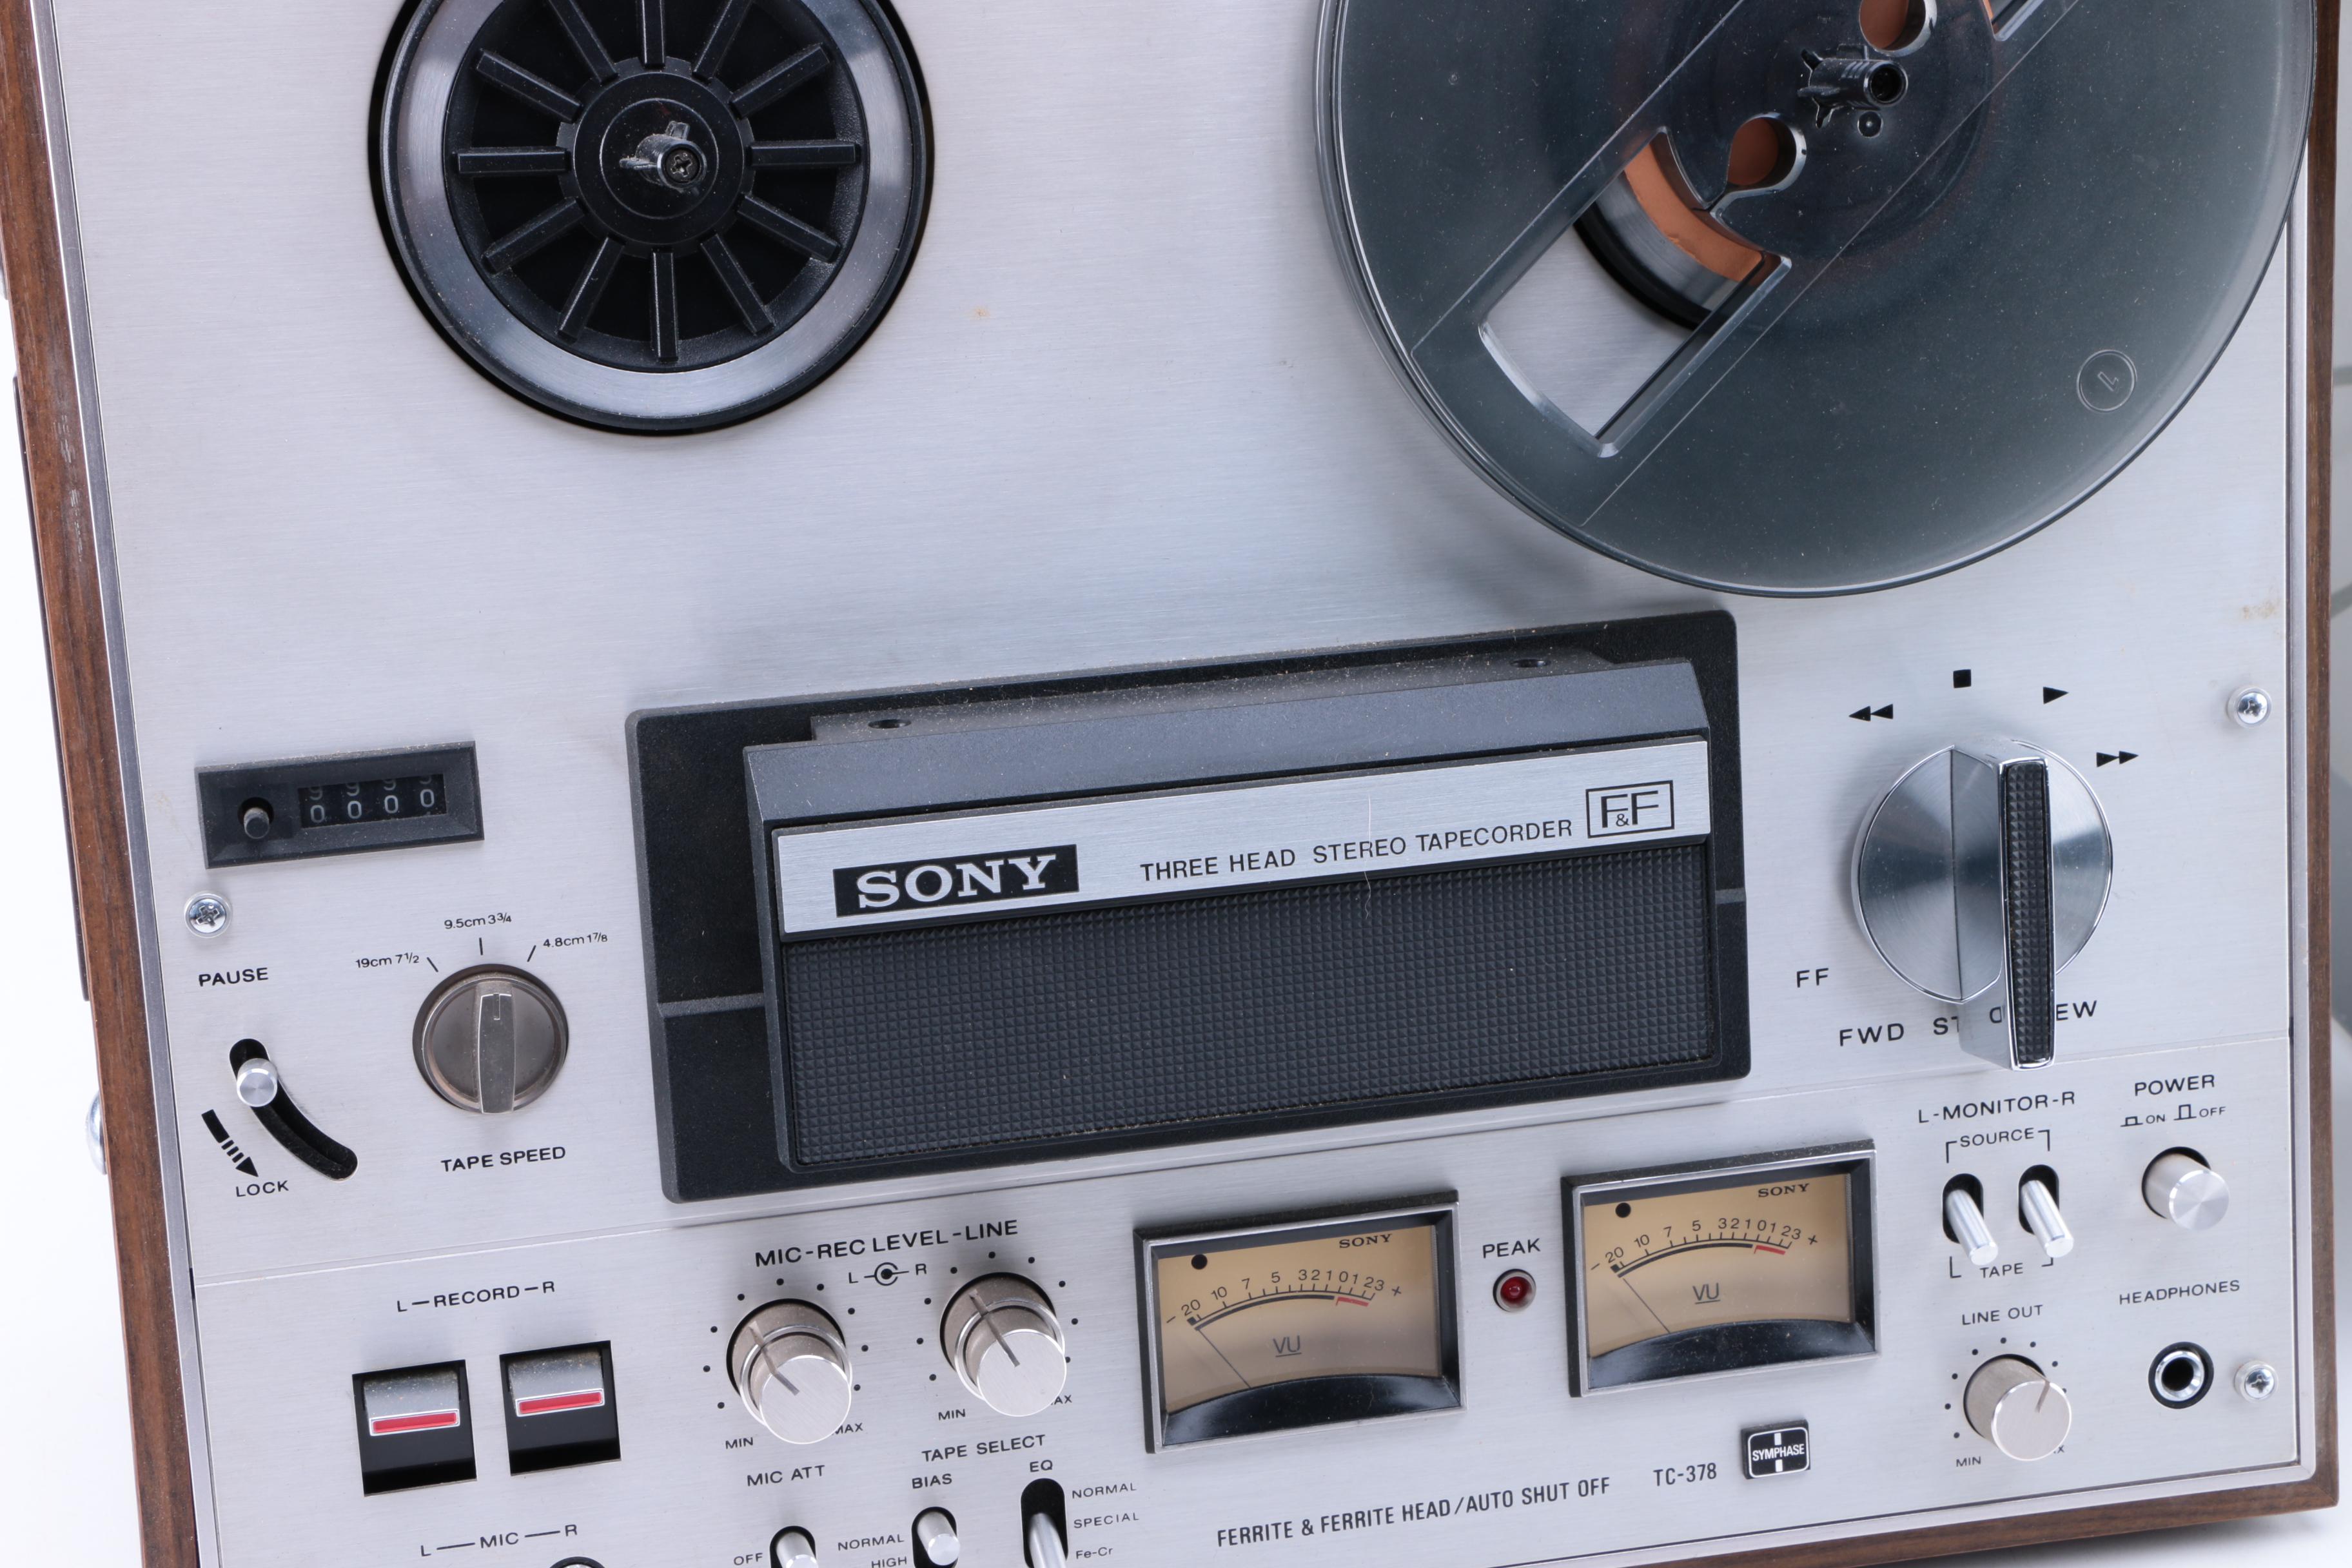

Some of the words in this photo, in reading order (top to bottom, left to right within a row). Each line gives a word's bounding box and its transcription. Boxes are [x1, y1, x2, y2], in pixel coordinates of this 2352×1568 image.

[1140, 857, 1218, 881] THREE
[1230, 849, 1295, 872] HEAD
[1313, 837, 1407, 864] STEREO
[1415, 819, 1573, 852] TAPECORDER
[856, 854, 1057, 909] SONY
[444, 918, 485, 929] 9.5cm
[544, 937, 584, 947] 4.8cm
[356, 957, 391, 968] 19cm
[199, 968, 268, 986] PAUSE
[1797, 968, 1828, 988] FF
[1840, 1023, 1904, 1046] FWD
[2055, 1000, 2097, 1021] EW
[2135, 1075, 2214, 1096] POWER
[2146, 1114, 2165, 1124] ON
[2199, 1106, 2225, 1117] OFF
[1961, 1128, 2034, 1147] SOURCE
[441, 1155, 493, 1171] TAPE
[500, 1147, 565, 1165] SPEED
[236, 1181, 288, 1197] LOCK
[1758, 1183, 1809, 1197] SONY
[756, 1240, 865, 1267] MIC-REC
[873, 1220, 1017, 1251] LEVEL-LINE
[1339, 1234, 1391, 1248] SONY
[1483, 1239, 1540, 1259] PEAK
[1605, 1247, 1624, 1264] 20
[1634, 1235, 1649, 1247] 10
[1663, 1226, 1671, 1237] 7
[1692, 1220, 1701, 1231] 5
[1718, 1218, 1727, 1229] 3
[1730, 1218, 1740, 1229] 2
[1745, 1219, 1750, 1229] 1
[1758, 1220, 1767, 1231] 0
[1771, 1222, 1776, 1233] 1
[1781, 1226, 1791, 1237] 2
[1792, 1228, 1801, 1239] 3
[848, 1273, 858, 1284] L
[916, 1264, 926, 1275] R
[1980, 1263, 2023, 1278] TAPE
[1181, 1300, 1200, 1316] 20
[1211, 1287, 1227, 1300] 10
[1242, 1278, 1250, 1289] 7
[1271, 1271, 1280, 1283] 5
[1298, 1269, 1307, 1280] 3
[1311, 1269, 1320, 1280] 2
[1327, 1270, 1331, 1280] 1
[1339, 1271, 1348, 1282] 0
[1353, 1274, 1358, 1284] 1
[1364, 1277, 1374, 1288] 2
[1375, 1280, 1384, 1291] 3
[1692, 1283, 1720, 1301] VU
[2120, 1280, 2239, 1304] HEADPHONES
[1963, 1310, 1999, 1325] LINE
[2008, 1305, 2043, 1319] OUT
[1273, 1336, 1301, 1354] VU
[1051, 1394, 1073, 1406] AX
[939, 1409, 965, 1420] MIN
[726, 1437, 753, 1449] MIN
[922, 1445, 967, 1462] TAPE
[977, 1435, 1045, 1455] SELECT
[1752, 1444, 1805, 1462] SYMPHASE
[1956, 1456, 1981, 1467] MIN
[1030, 1460, 1052, 1472] EQ
[1653, 1463, 1716, 1486] TC-378
[747, 1471, 782, 1486] MIC
[792, 1465, 825, 1480] ATT
[912, 1474, 952, 1489] BIAS
[1072, 1483, 1135, 1498] NORMAL
[1074, 1513, 1139, 1528] SPECIAL
[1218, 1522, 1293, 1547] FERRITE
[1302, 1519, 1314, 1536] &
[1321, 1507, 1394, 1533] FERRITE
[1522, 1483, 1569, 1505] SHUT
[1578, 1477, 1609, 1496] OFF
[838, 1534, 904, 1551] NORMAL
[734, 1553, 762, 1565] OFF
[872, 1556, 906, 1568] HIGH
[1076, 1547, 1112, 1559] Fe-Cr
